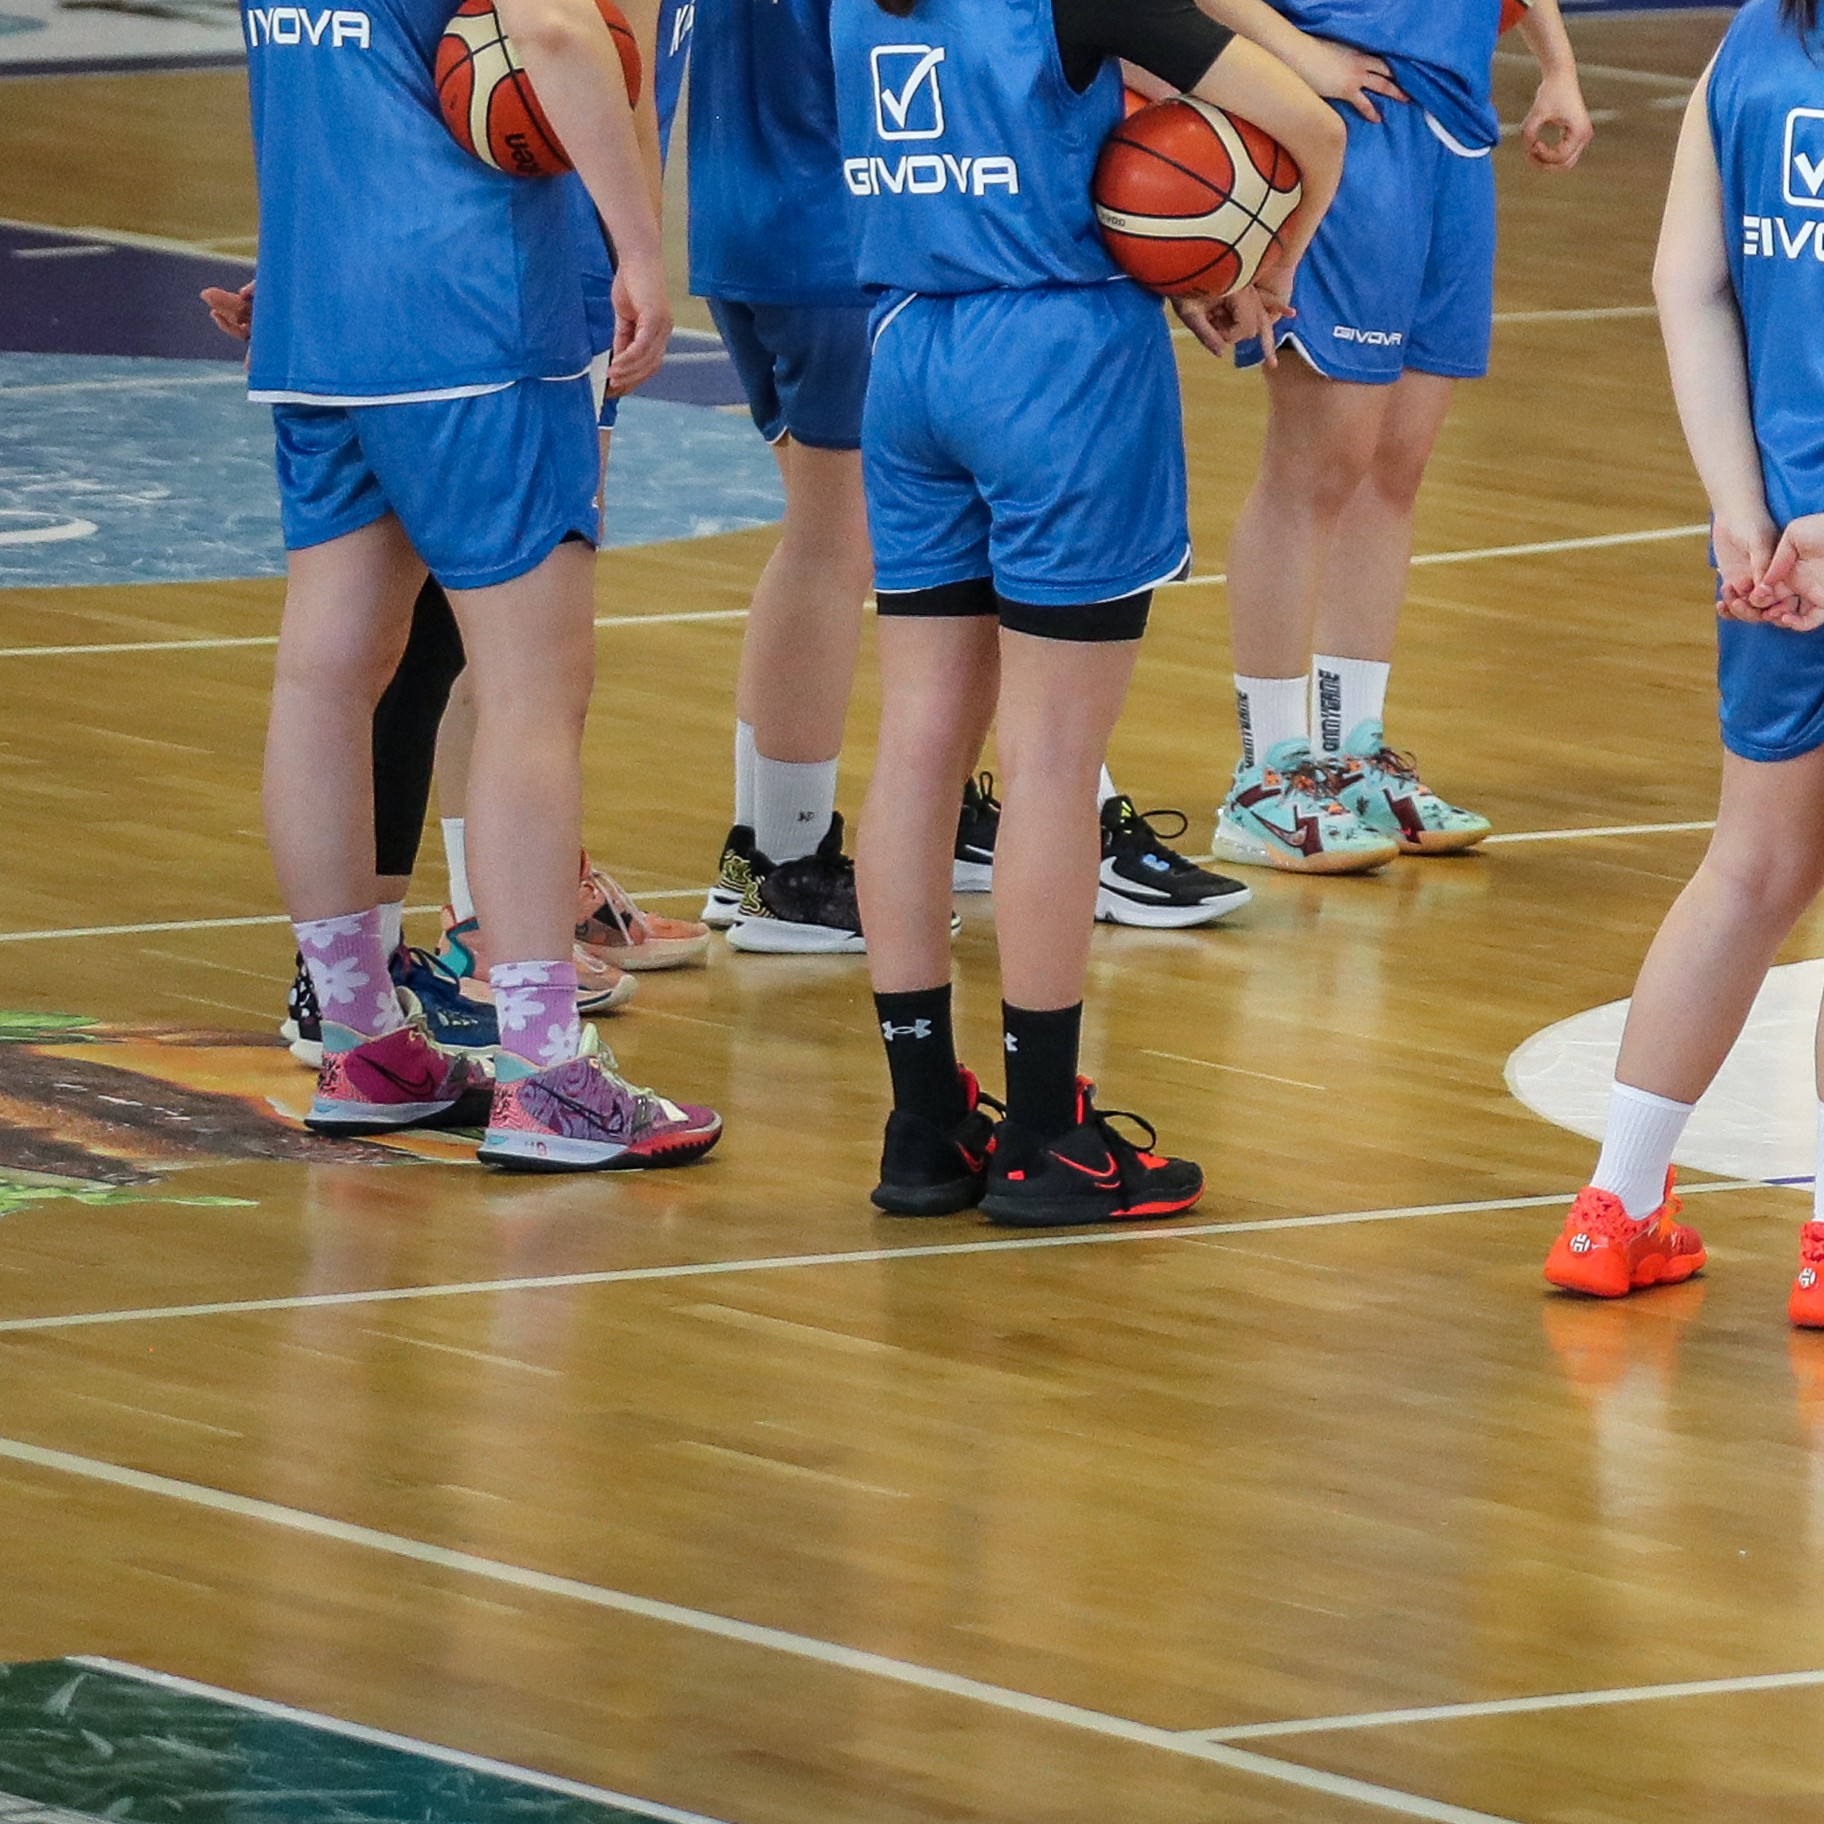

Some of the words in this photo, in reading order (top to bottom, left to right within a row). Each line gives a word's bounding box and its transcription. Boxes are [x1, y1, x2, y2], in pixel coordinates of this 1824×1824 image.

[248, 5, 371, 49] IVOVA
[843, 154, 1019, 196] GIVOVA
[1333, 325, 1402, 346] GIVOVA
